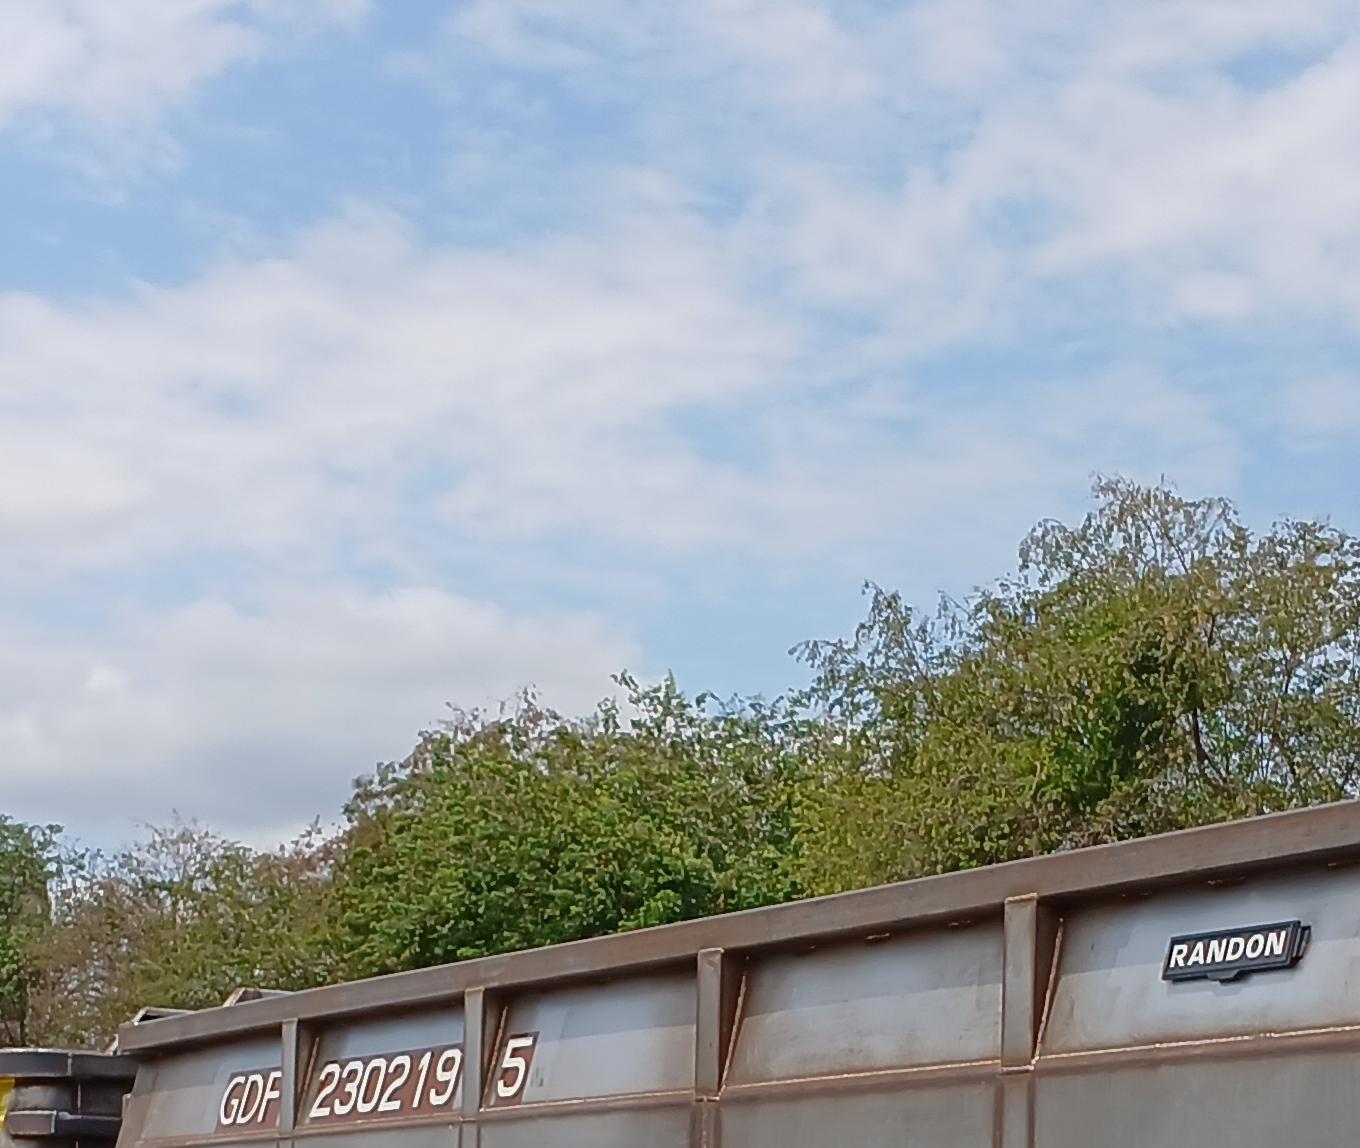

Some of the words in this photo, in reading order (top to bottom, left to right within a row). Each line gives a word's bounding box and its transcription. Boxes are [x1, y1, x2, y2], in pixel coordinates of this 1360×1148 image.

[1169, 930, 1287, 968] RANDON
[220, 1071, 282, 1125] GDF
[309, 1049, 463, 1118] 230219
[497, 1037, 533, 1097] 5
